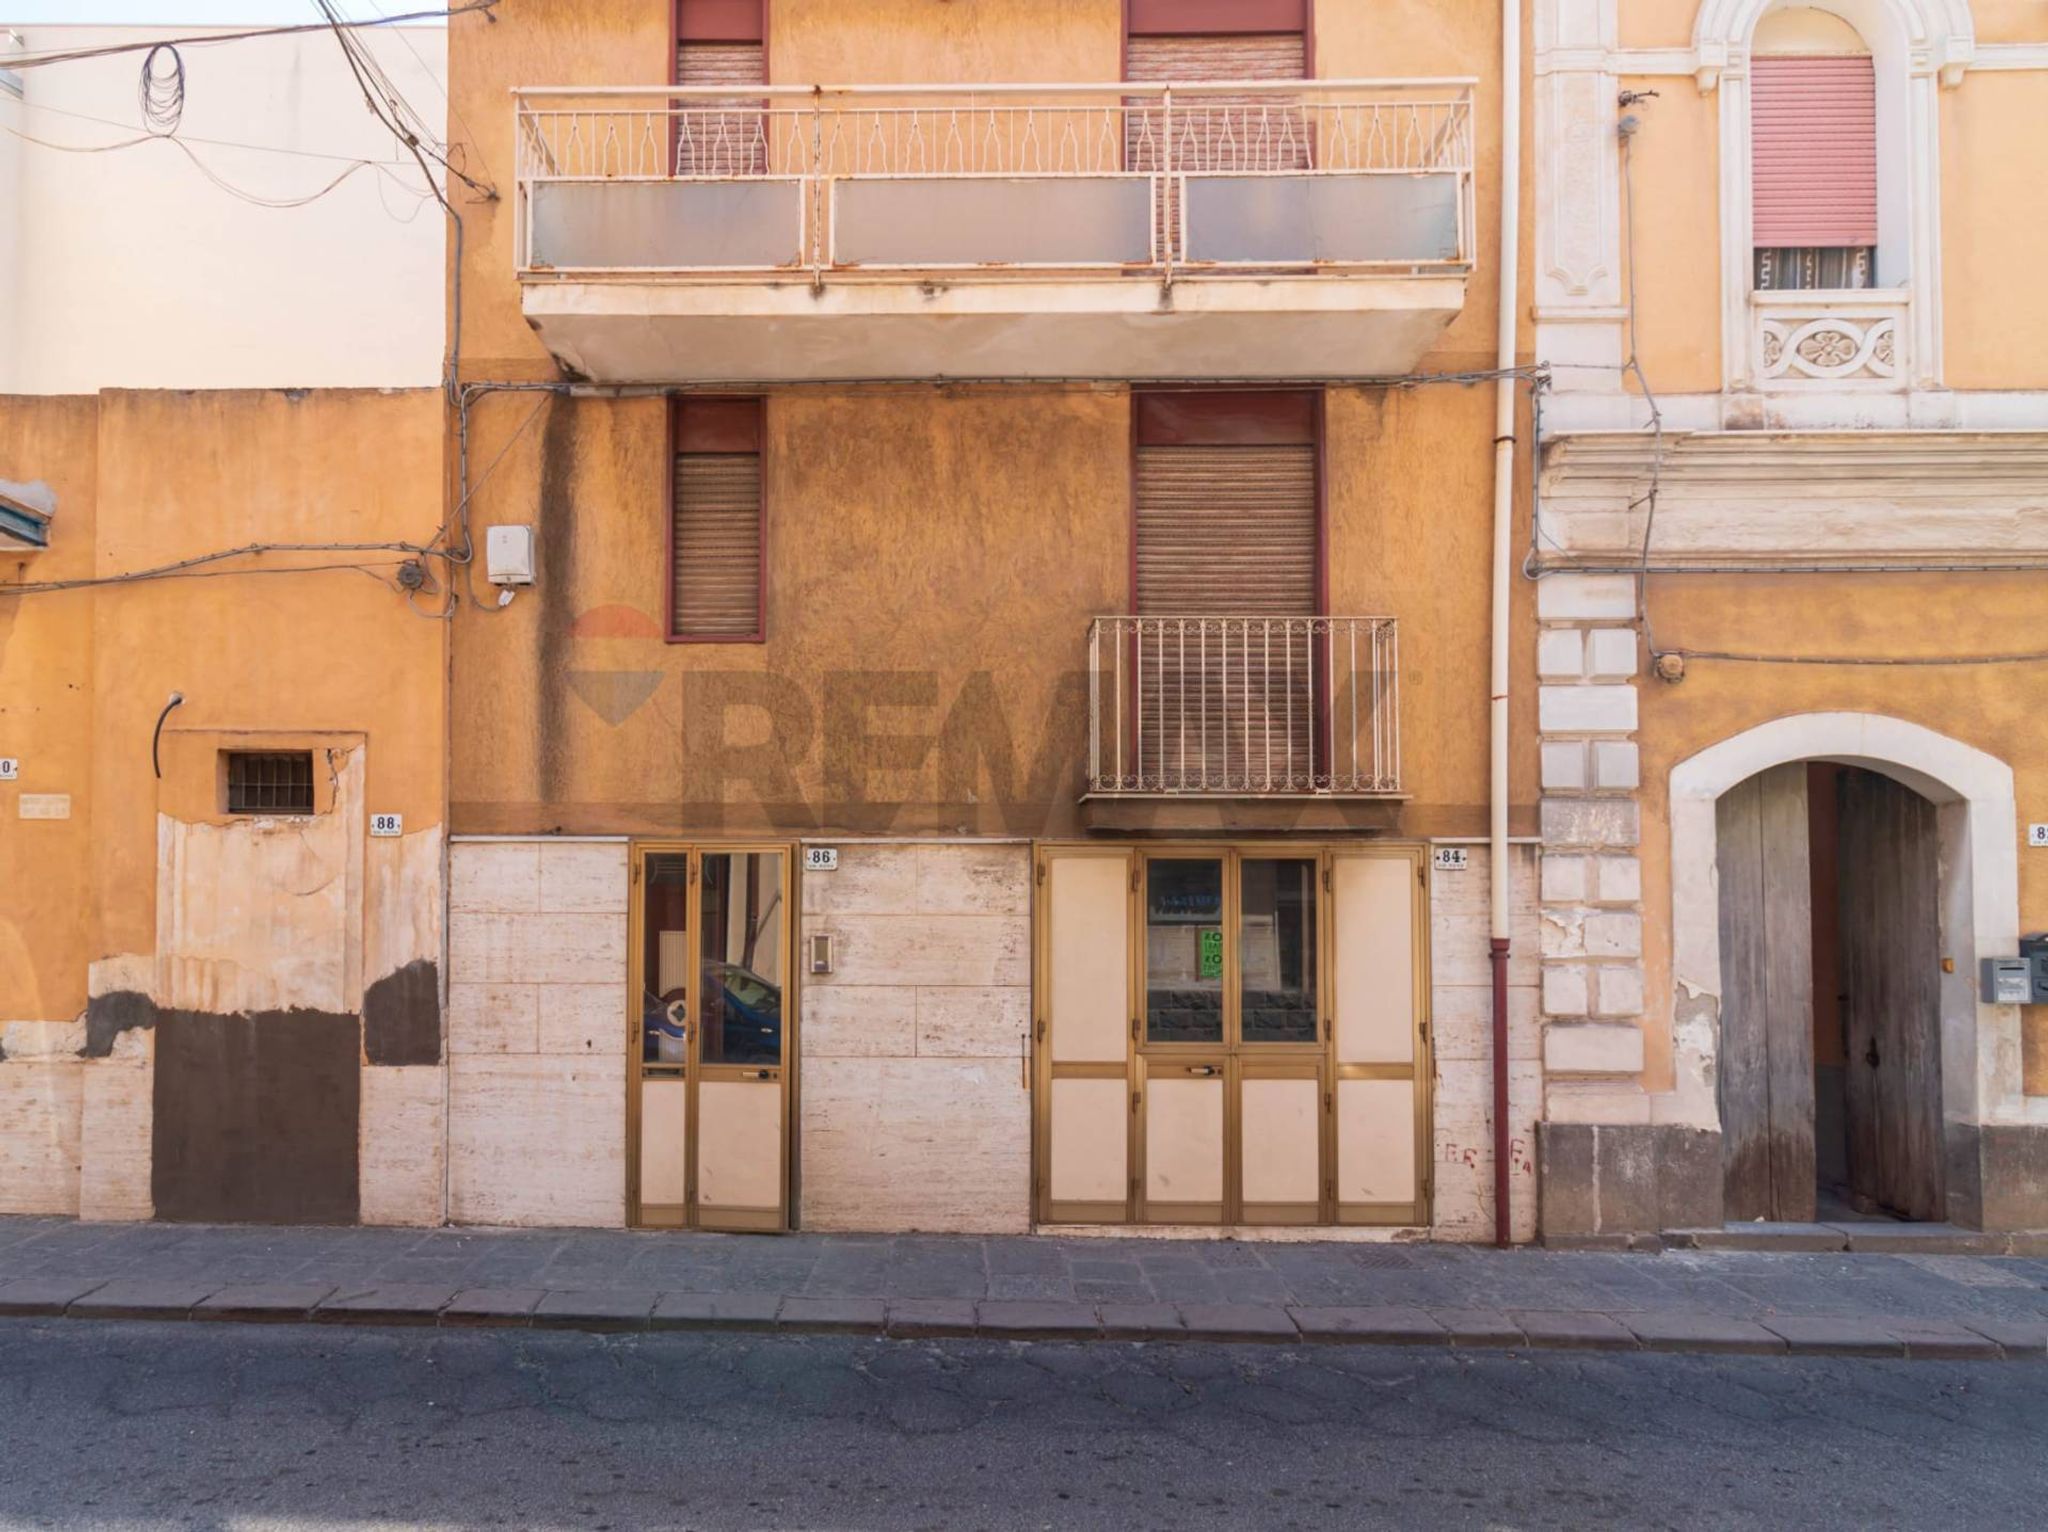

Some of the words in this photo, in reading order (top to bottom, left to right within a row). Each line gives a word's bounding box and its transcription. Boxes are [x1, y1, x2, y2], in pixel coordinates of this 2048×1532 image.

[377, 816, 395, 829] 88
[2036, 826, 2048, 840] 8
[812, 850, 830, 863] 86
[1442, 850, 1460, 863] 84
